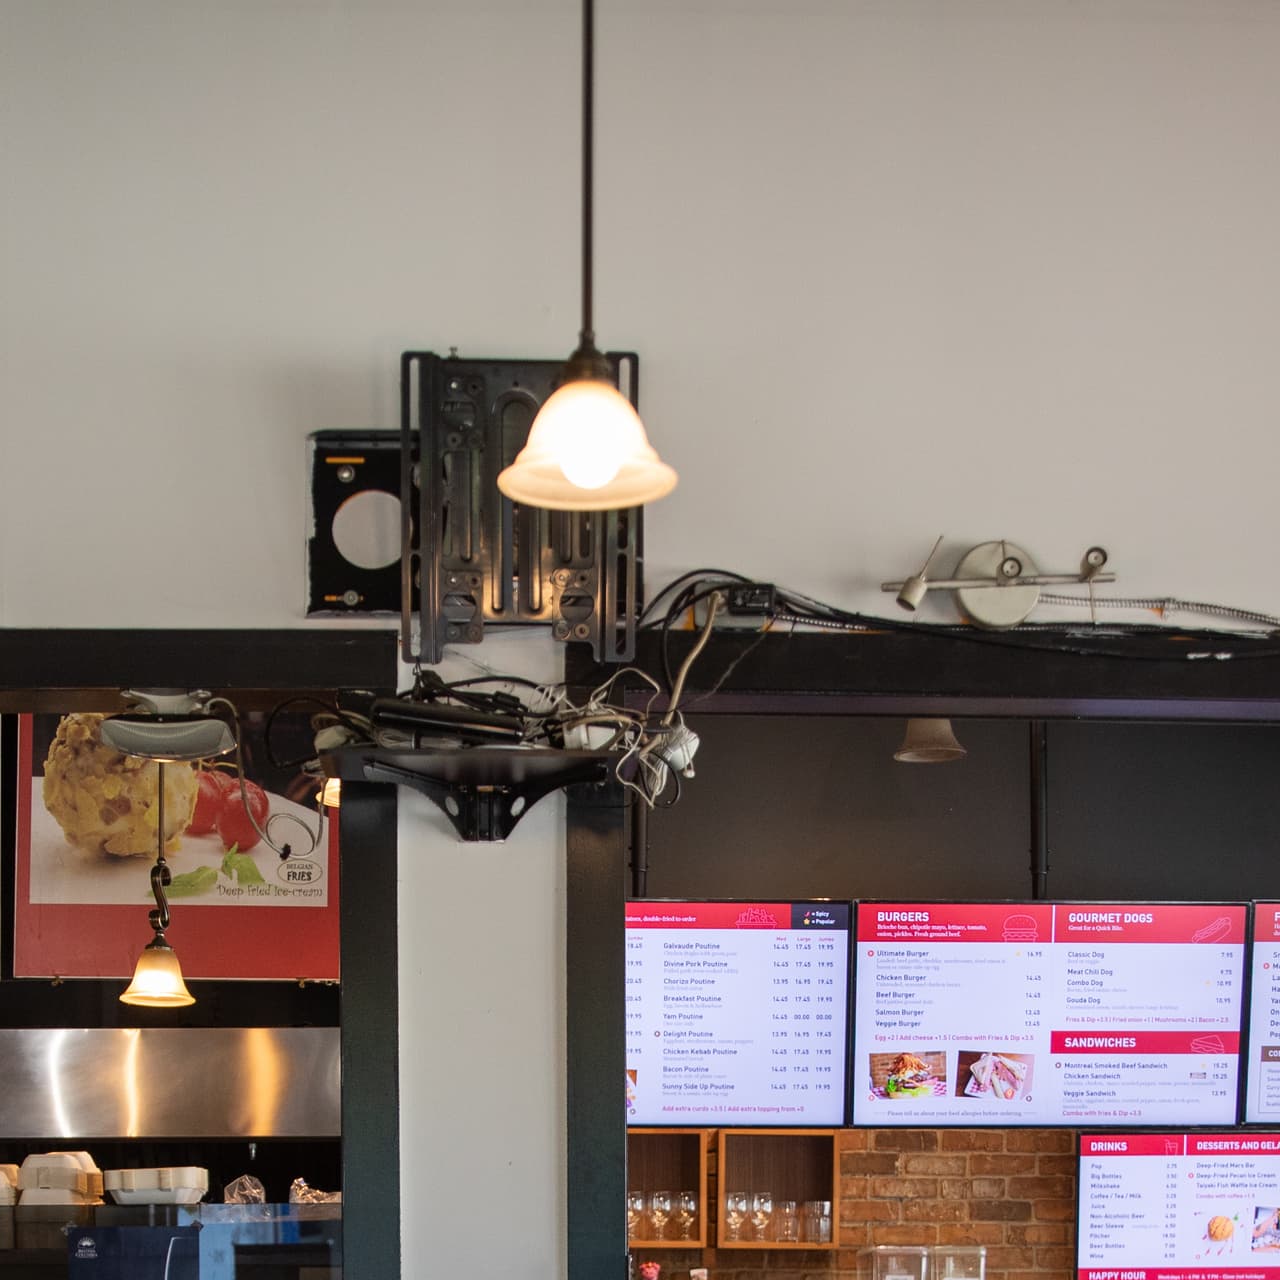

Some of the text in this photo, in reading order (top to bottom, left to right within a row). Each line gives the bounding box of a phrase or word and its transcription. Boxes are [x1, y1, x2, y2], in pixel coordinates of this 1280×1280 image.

[286, 862, 314, 871] BELGIAN
[287, 870, 312, 882] FRIES
[218, 884, 244, 898] Deep
[878, 912, 929, 922] BURGERS
[1069, 913, 1153, 923] GOURMET DOGS
[1064, 1038, 1136, 1048] SANDWICHES
[662, 1083, 682, 1091] Sunny
[700, 1083, 708, 1091] Up
[1090, 1142, 1127, 1152] DRINKS
[1197, 1141, 1240, 1150] DESSERTS
[1241, 1141, 1259, 1150] AND
[1089, 1272, 1146, 1280] HAPPY HOUR
